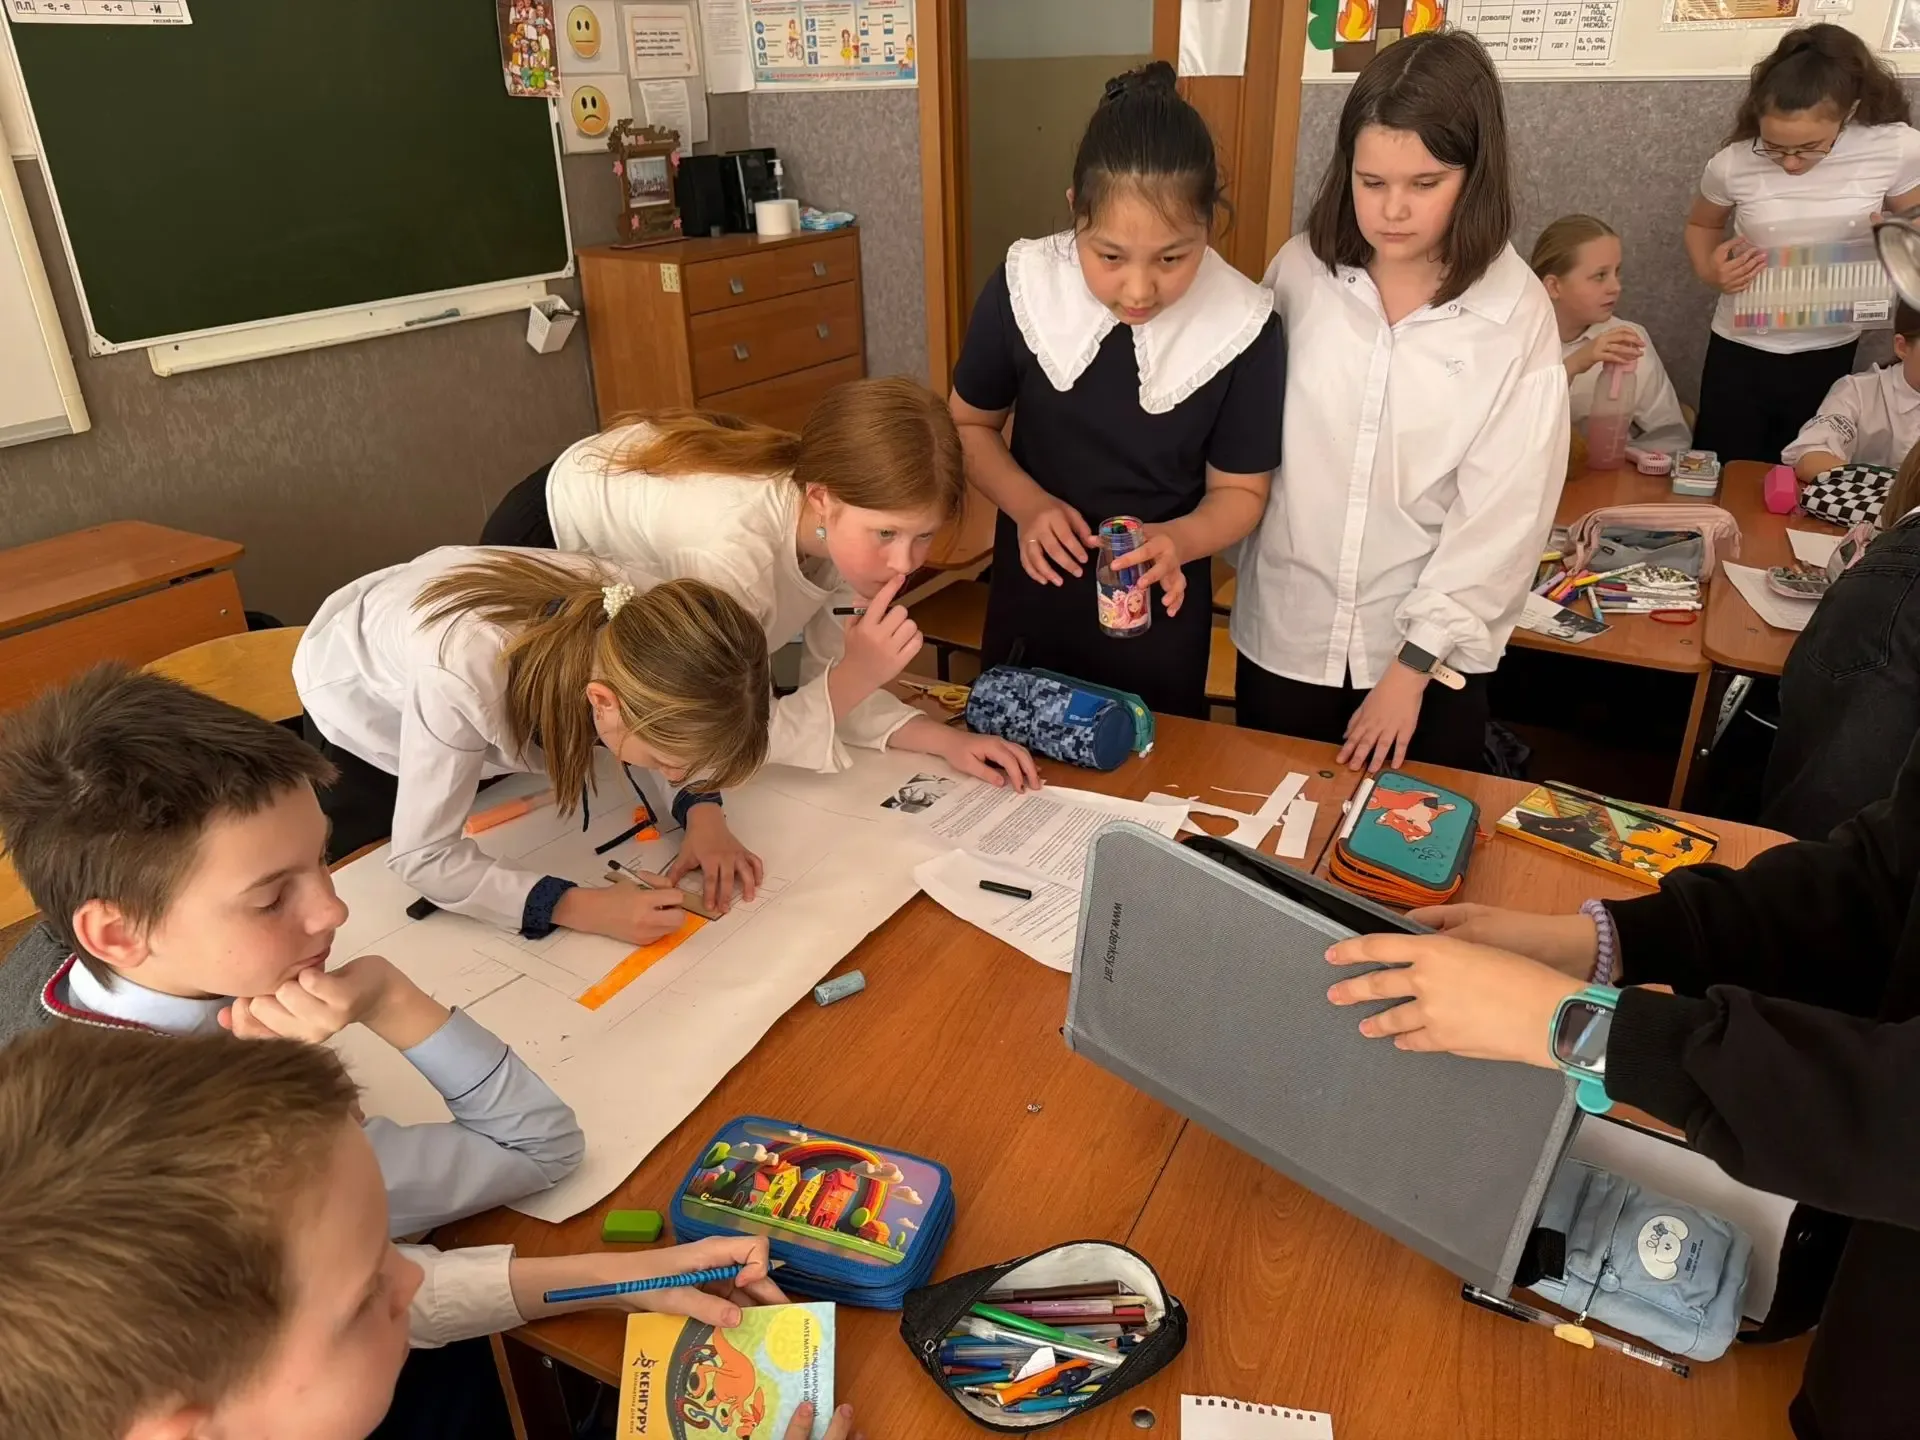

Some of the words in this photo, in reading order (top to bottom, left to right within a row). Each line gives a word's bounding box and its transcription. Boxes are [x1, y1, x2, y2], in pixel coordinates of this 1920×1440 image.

[1480, 14, 1511, 22] ДОВОЛЕН
[802, 1318, 811, 1389] МАТЕМАТИЧЕСКИЙ
[810, 1345, 821, 1417] МЕЖДУНАРОДНЫЙ
[636, 1371, 651, 1434] КЕНГУРУ
